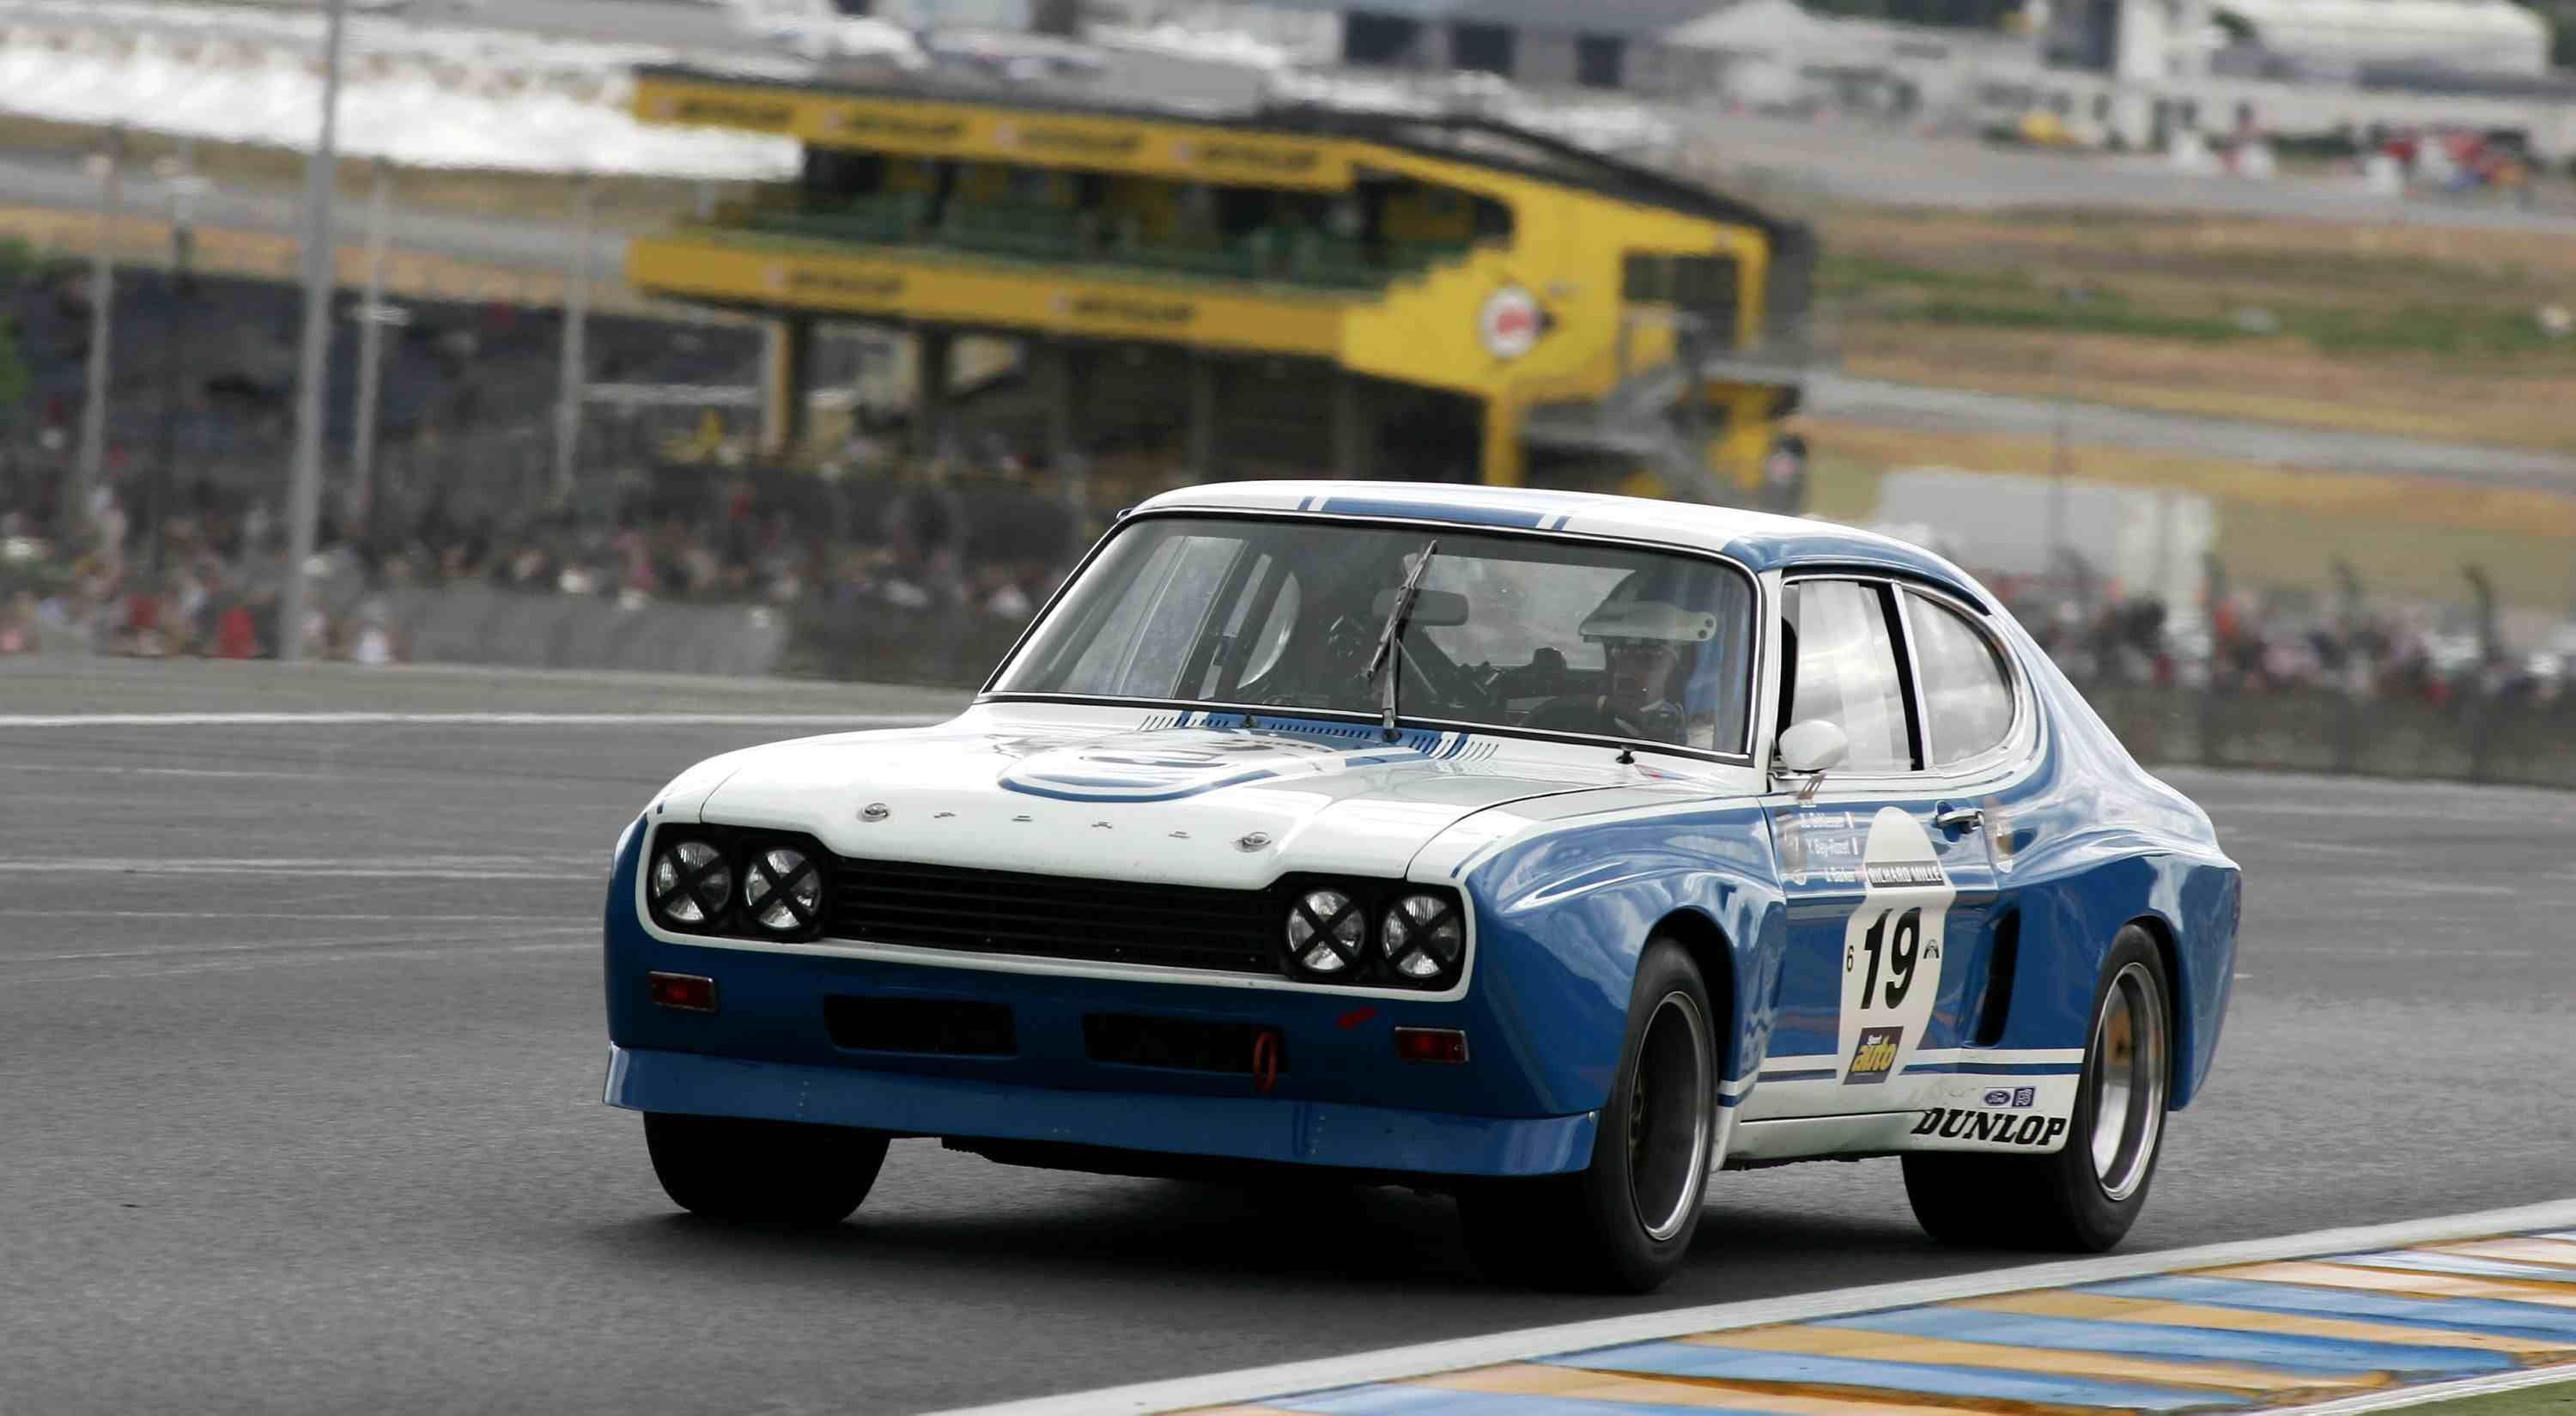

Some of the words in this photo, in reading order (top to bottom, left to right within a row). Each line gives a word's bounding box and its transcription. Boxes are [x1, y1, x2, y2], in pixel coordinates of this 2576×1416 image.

[1868, 866, 1911, 884] RICHARD
[1911, 866, 1943, 882] MILLE
[1846, 945, 1855, 972] 6
[1861, 907, 1922, 1009] 19
[1850, 1036, 1897, 1072] auto
[1910, 1107, 2067, 1146] DUNLOP
